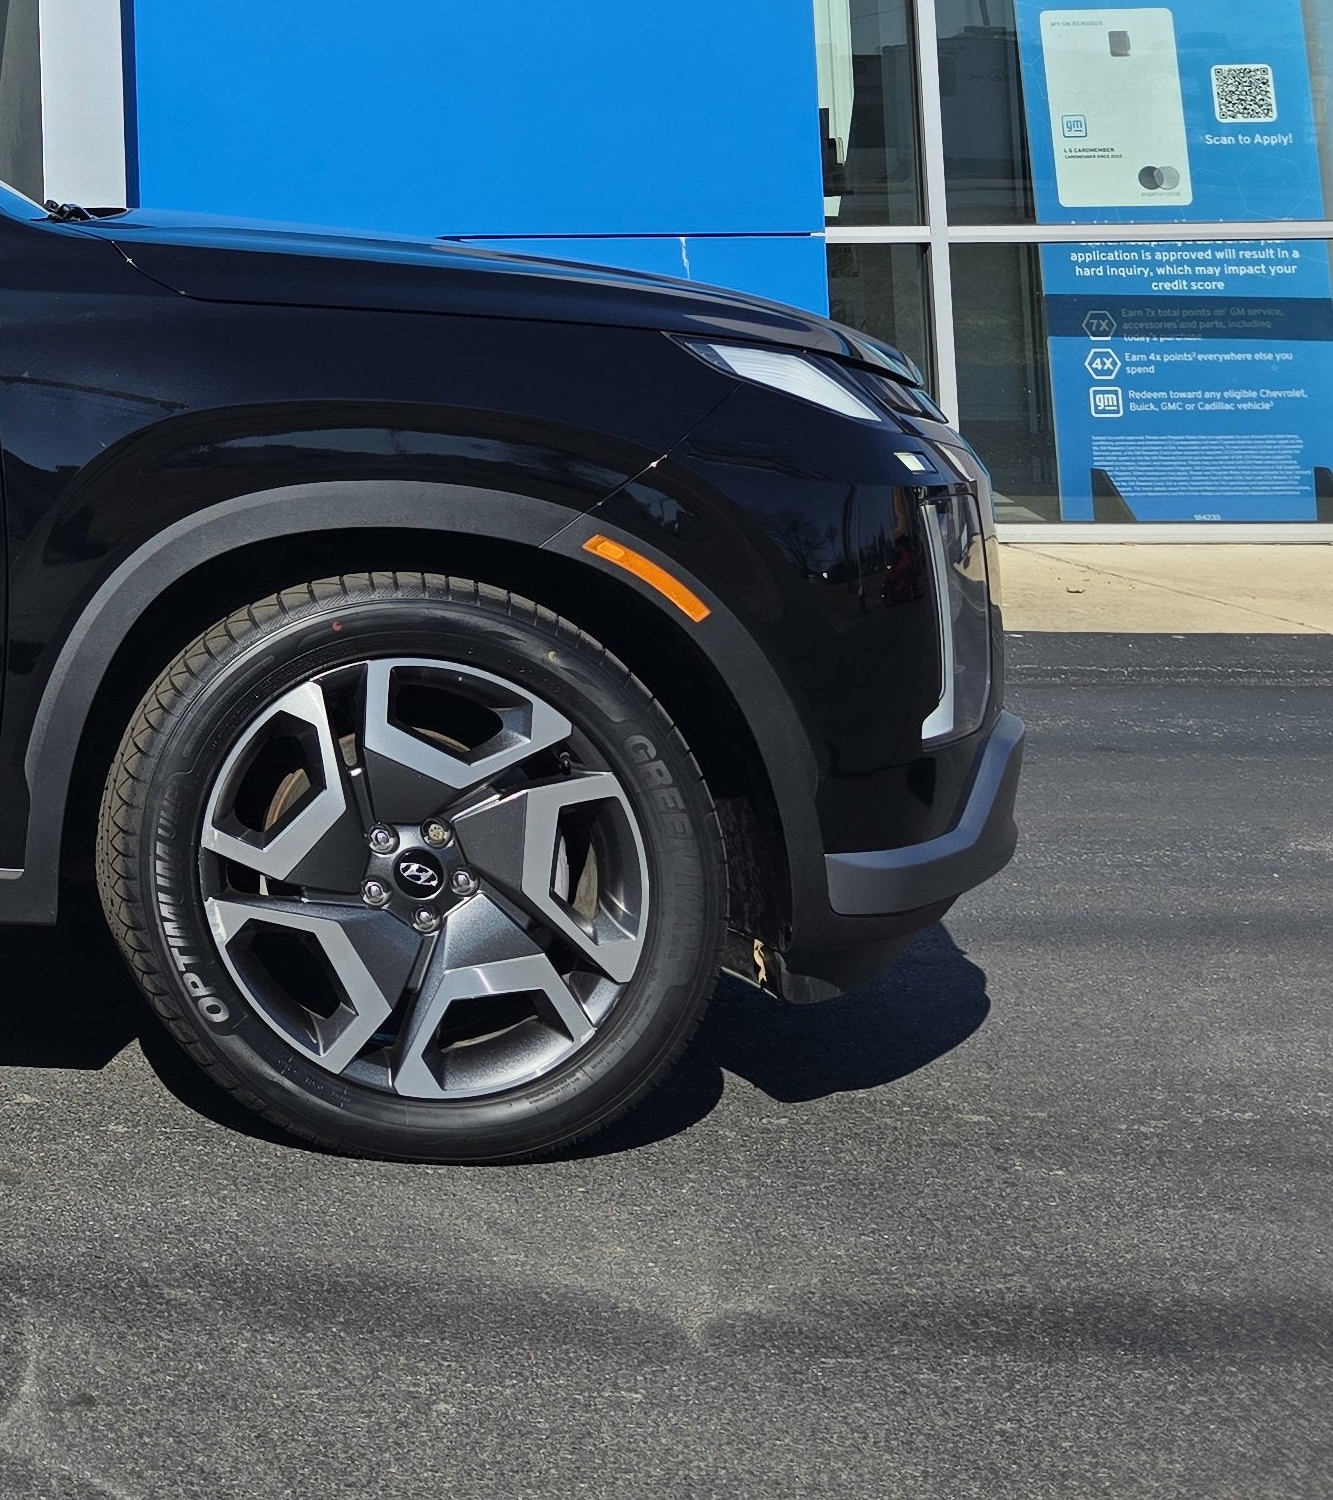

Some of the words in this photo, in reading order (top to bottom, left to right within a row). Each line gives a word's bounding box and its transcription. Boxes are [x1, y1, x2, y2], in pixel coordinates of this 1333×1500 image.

[1205, 134, 1235, 145] Scan
[1238, 134, 1251, 144] to
[1254, 133, 1293, 146] Apply!
[1070, 250, 1138, 262] application
[1141, 250, 1152, 260] is
[1155, 250, 1212, 261] approved
[1214, 249, 1235, 259] will
[1239, 249, 1275, 259] result
[1278, 248, 1289, 259] in
[1292, 251, 1300, 259] a
[1075, 266, 1104, 276] hard
[1107, 265, 1154, 277] inquiry,
[1155, 264, 1192, 275] which
[1195, 266, 1221, 277] may
[1224, 264, 1266, 276] impact
[1269, 265, 1297, 276] your
[1152, 280, 1188, 290] credit
[1191, 281, 1225, 290] score
[1121, 308, 1143, 317] Earn
[1158, 307, 1180, 317] total
[1181, 307, 1211, 318] points
[1089, 320, 1110, 331] 7X
[1180, 320, 1197, 329] and
[1124, 353, 1146, 362] Earn
[1148, 353, 1162, 361] 4x
[1197, 352, 1252, 362] everywhere
[1254, 352, 1273, 361] else
[1274, 352, 1293, 362] you
[1091, 357, 1114, 369] 4X
[1125, 365, 1155, 375] spend
[1128, 390, 1167, 399] Redeem
[1169, 390, 1202, 399] toward
[1203, 391, 1221, 400] any
[1223, 389, 1258, 400] eligible
[1095, 394, 1117, 410] gm
[1161, 401, 1183, 411] GMC
[1185, 403, 1195, 411] or
[1197, 401, 1234, 411] Cadillac
